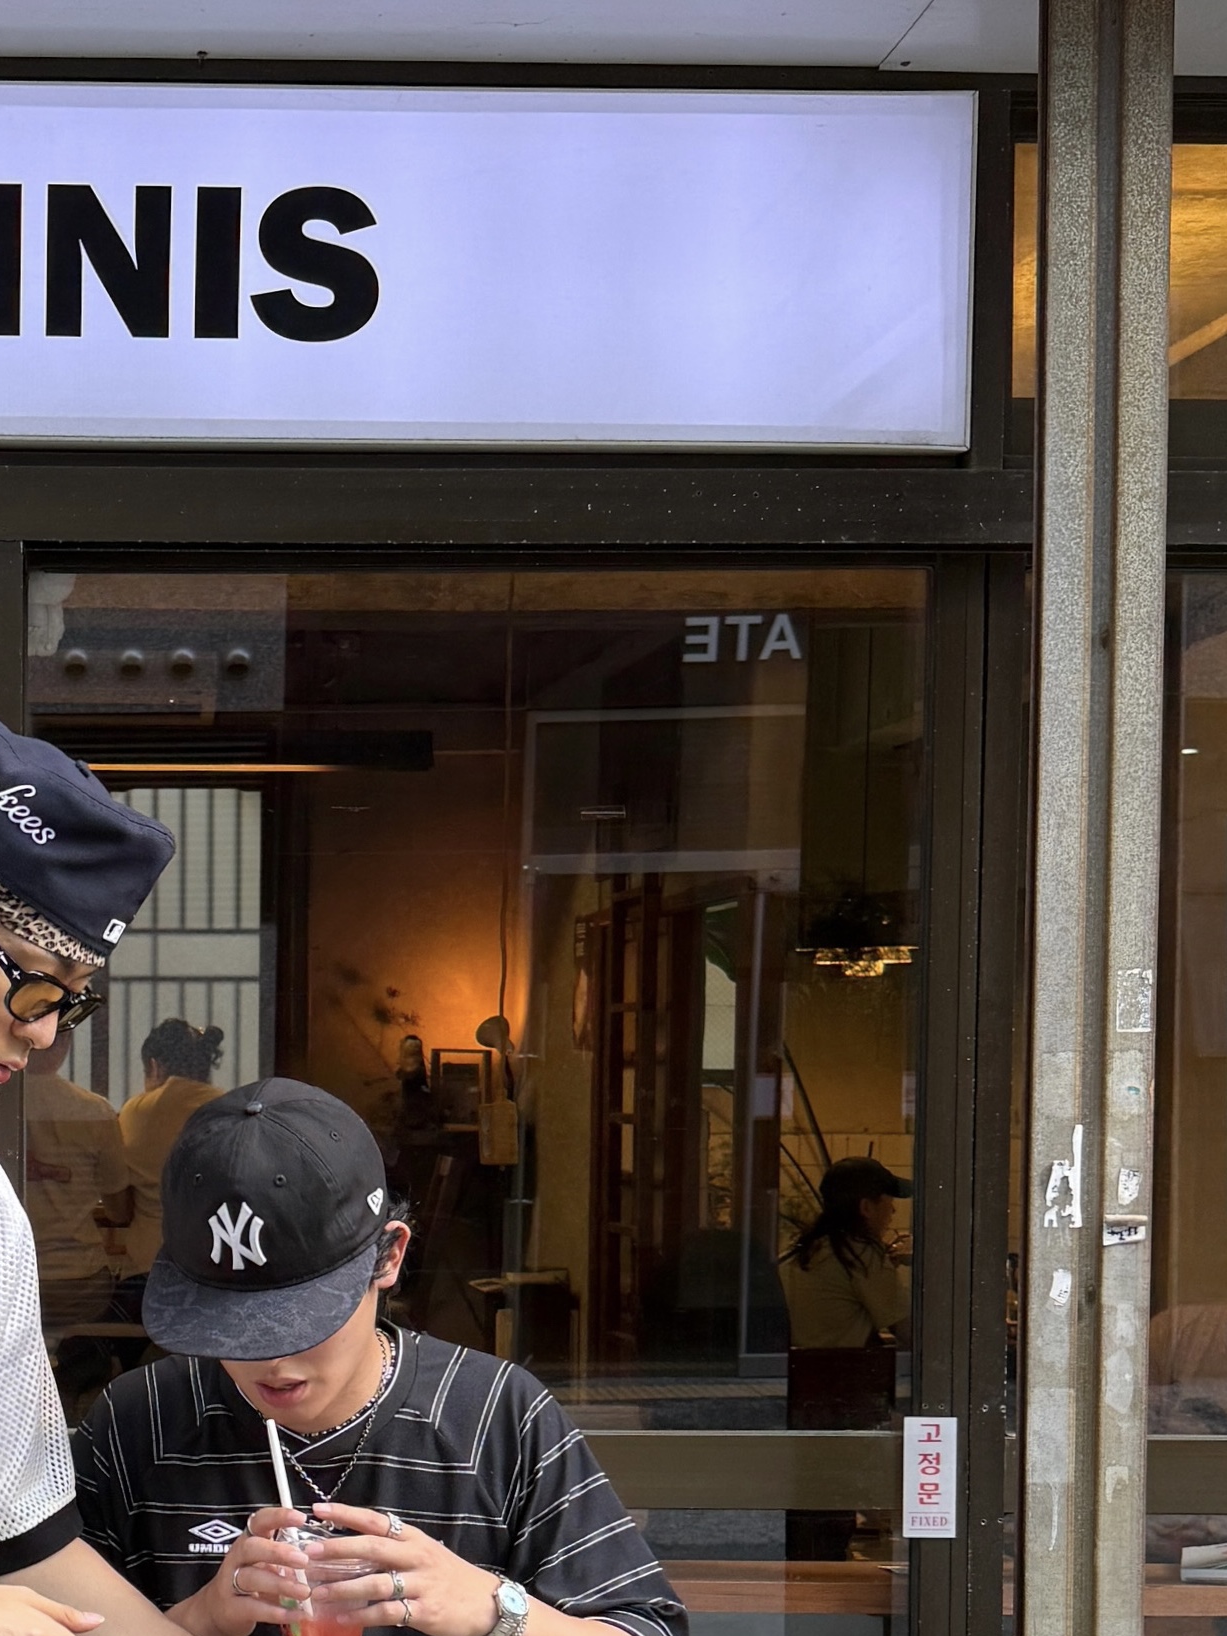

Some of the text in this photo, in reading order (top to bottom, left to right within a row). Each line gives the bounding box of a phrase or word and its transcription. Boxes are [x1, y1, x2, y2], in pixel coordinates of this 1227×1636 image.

[207, 1201, 268, 1271] NY
[917, 1423, 943, 1505] 고정문
[910, 1516, 948, 1527] FIXED
